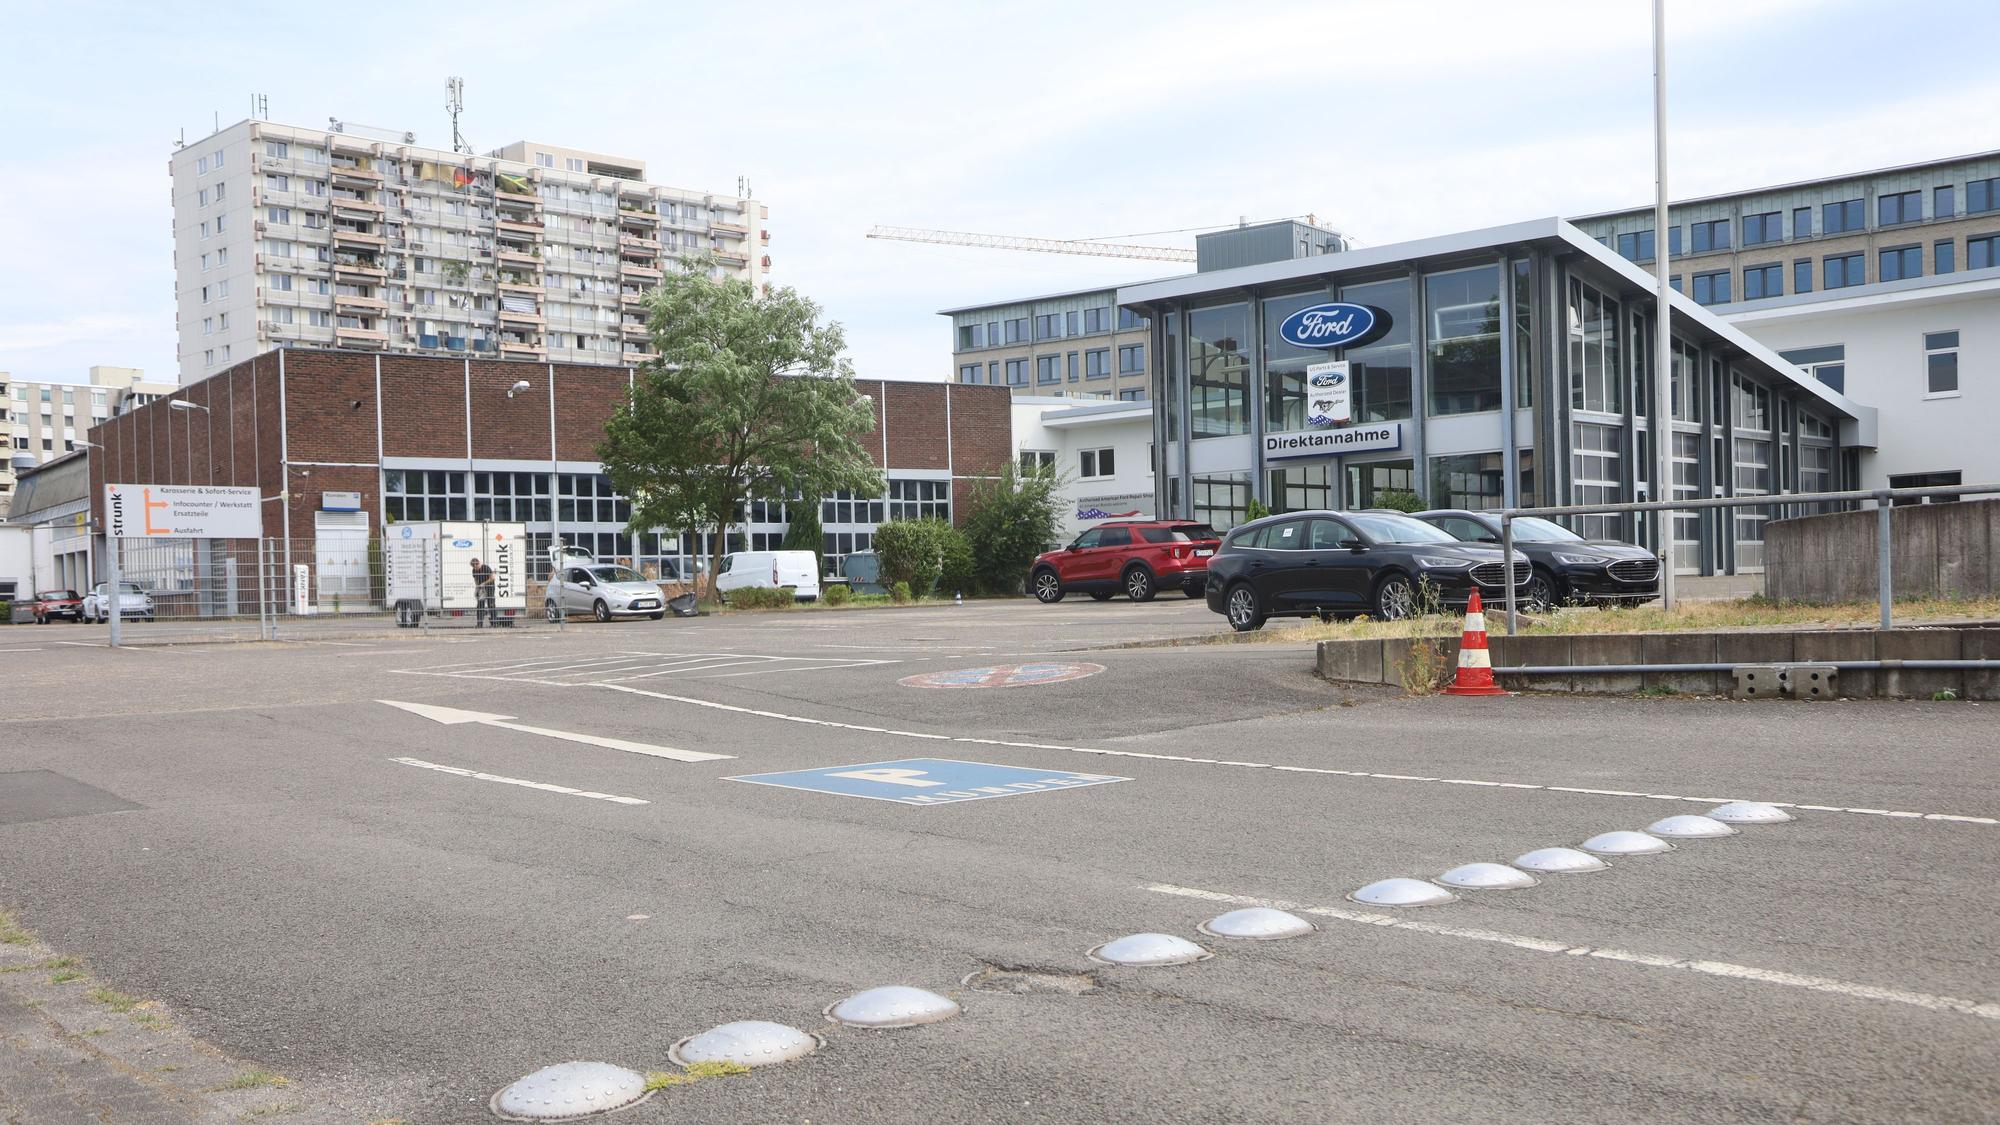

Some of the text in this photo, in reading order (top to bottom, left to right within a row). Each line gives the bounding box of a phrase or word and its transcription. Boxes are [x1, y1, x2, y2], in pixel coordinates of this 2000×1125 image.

[1296, 309, 1354, 340] Ford
[1316, 374, 1338, 386] Ford
[1267, 430, 1390, 450] Direktannahme
[160, 487, 196, 495] Karosserie
[205, 488, 251, 496] Sofort-Service
[110, 493, 123, 536] strunk
[496, 544, 508, 598] strunk
[824, 767, 948, 788] P
[901, 773, 1112, 803] KUNDEN
